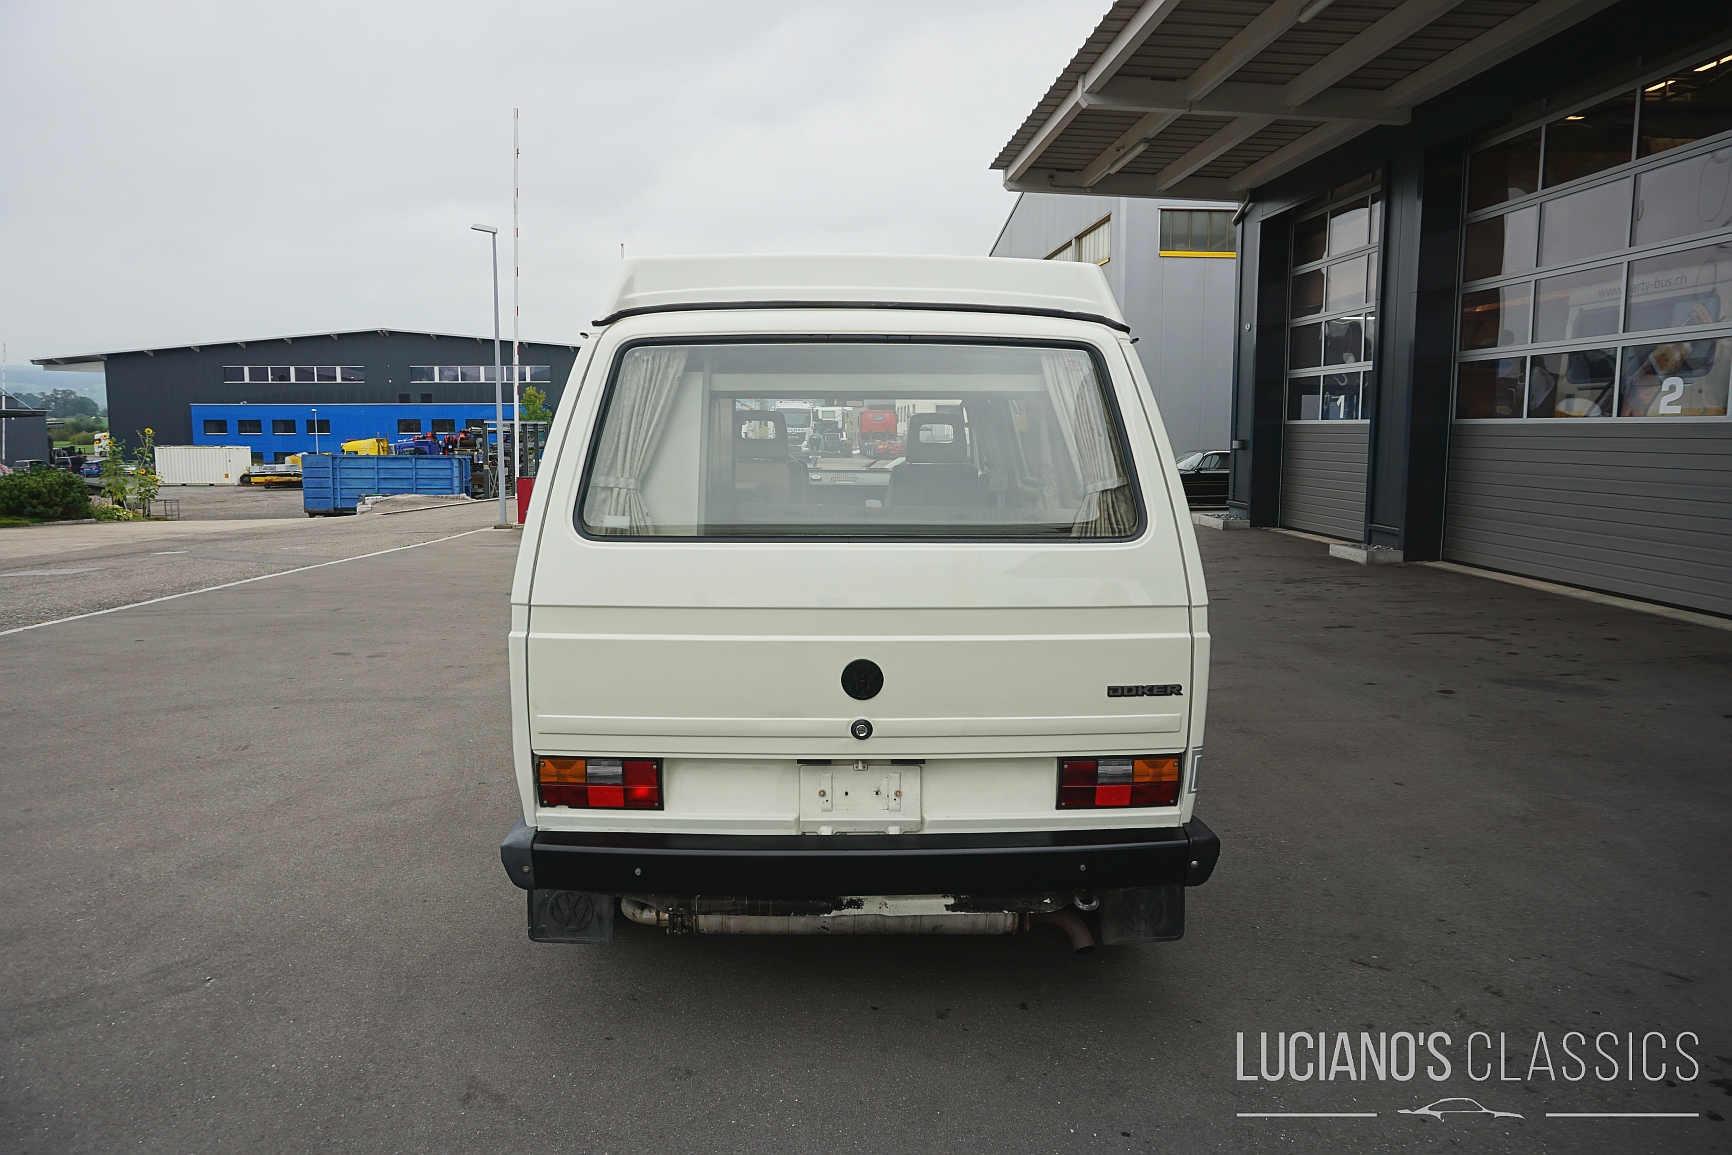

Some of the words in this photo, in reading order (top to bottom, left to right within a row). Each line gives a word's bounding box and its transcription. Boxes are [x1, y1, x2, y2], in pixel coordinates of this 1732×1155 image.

[1336, 395, 1345, 419] 1
[1658, 376, 1684, 414] 2
[1107, 683, 1184, 698] JOKER
